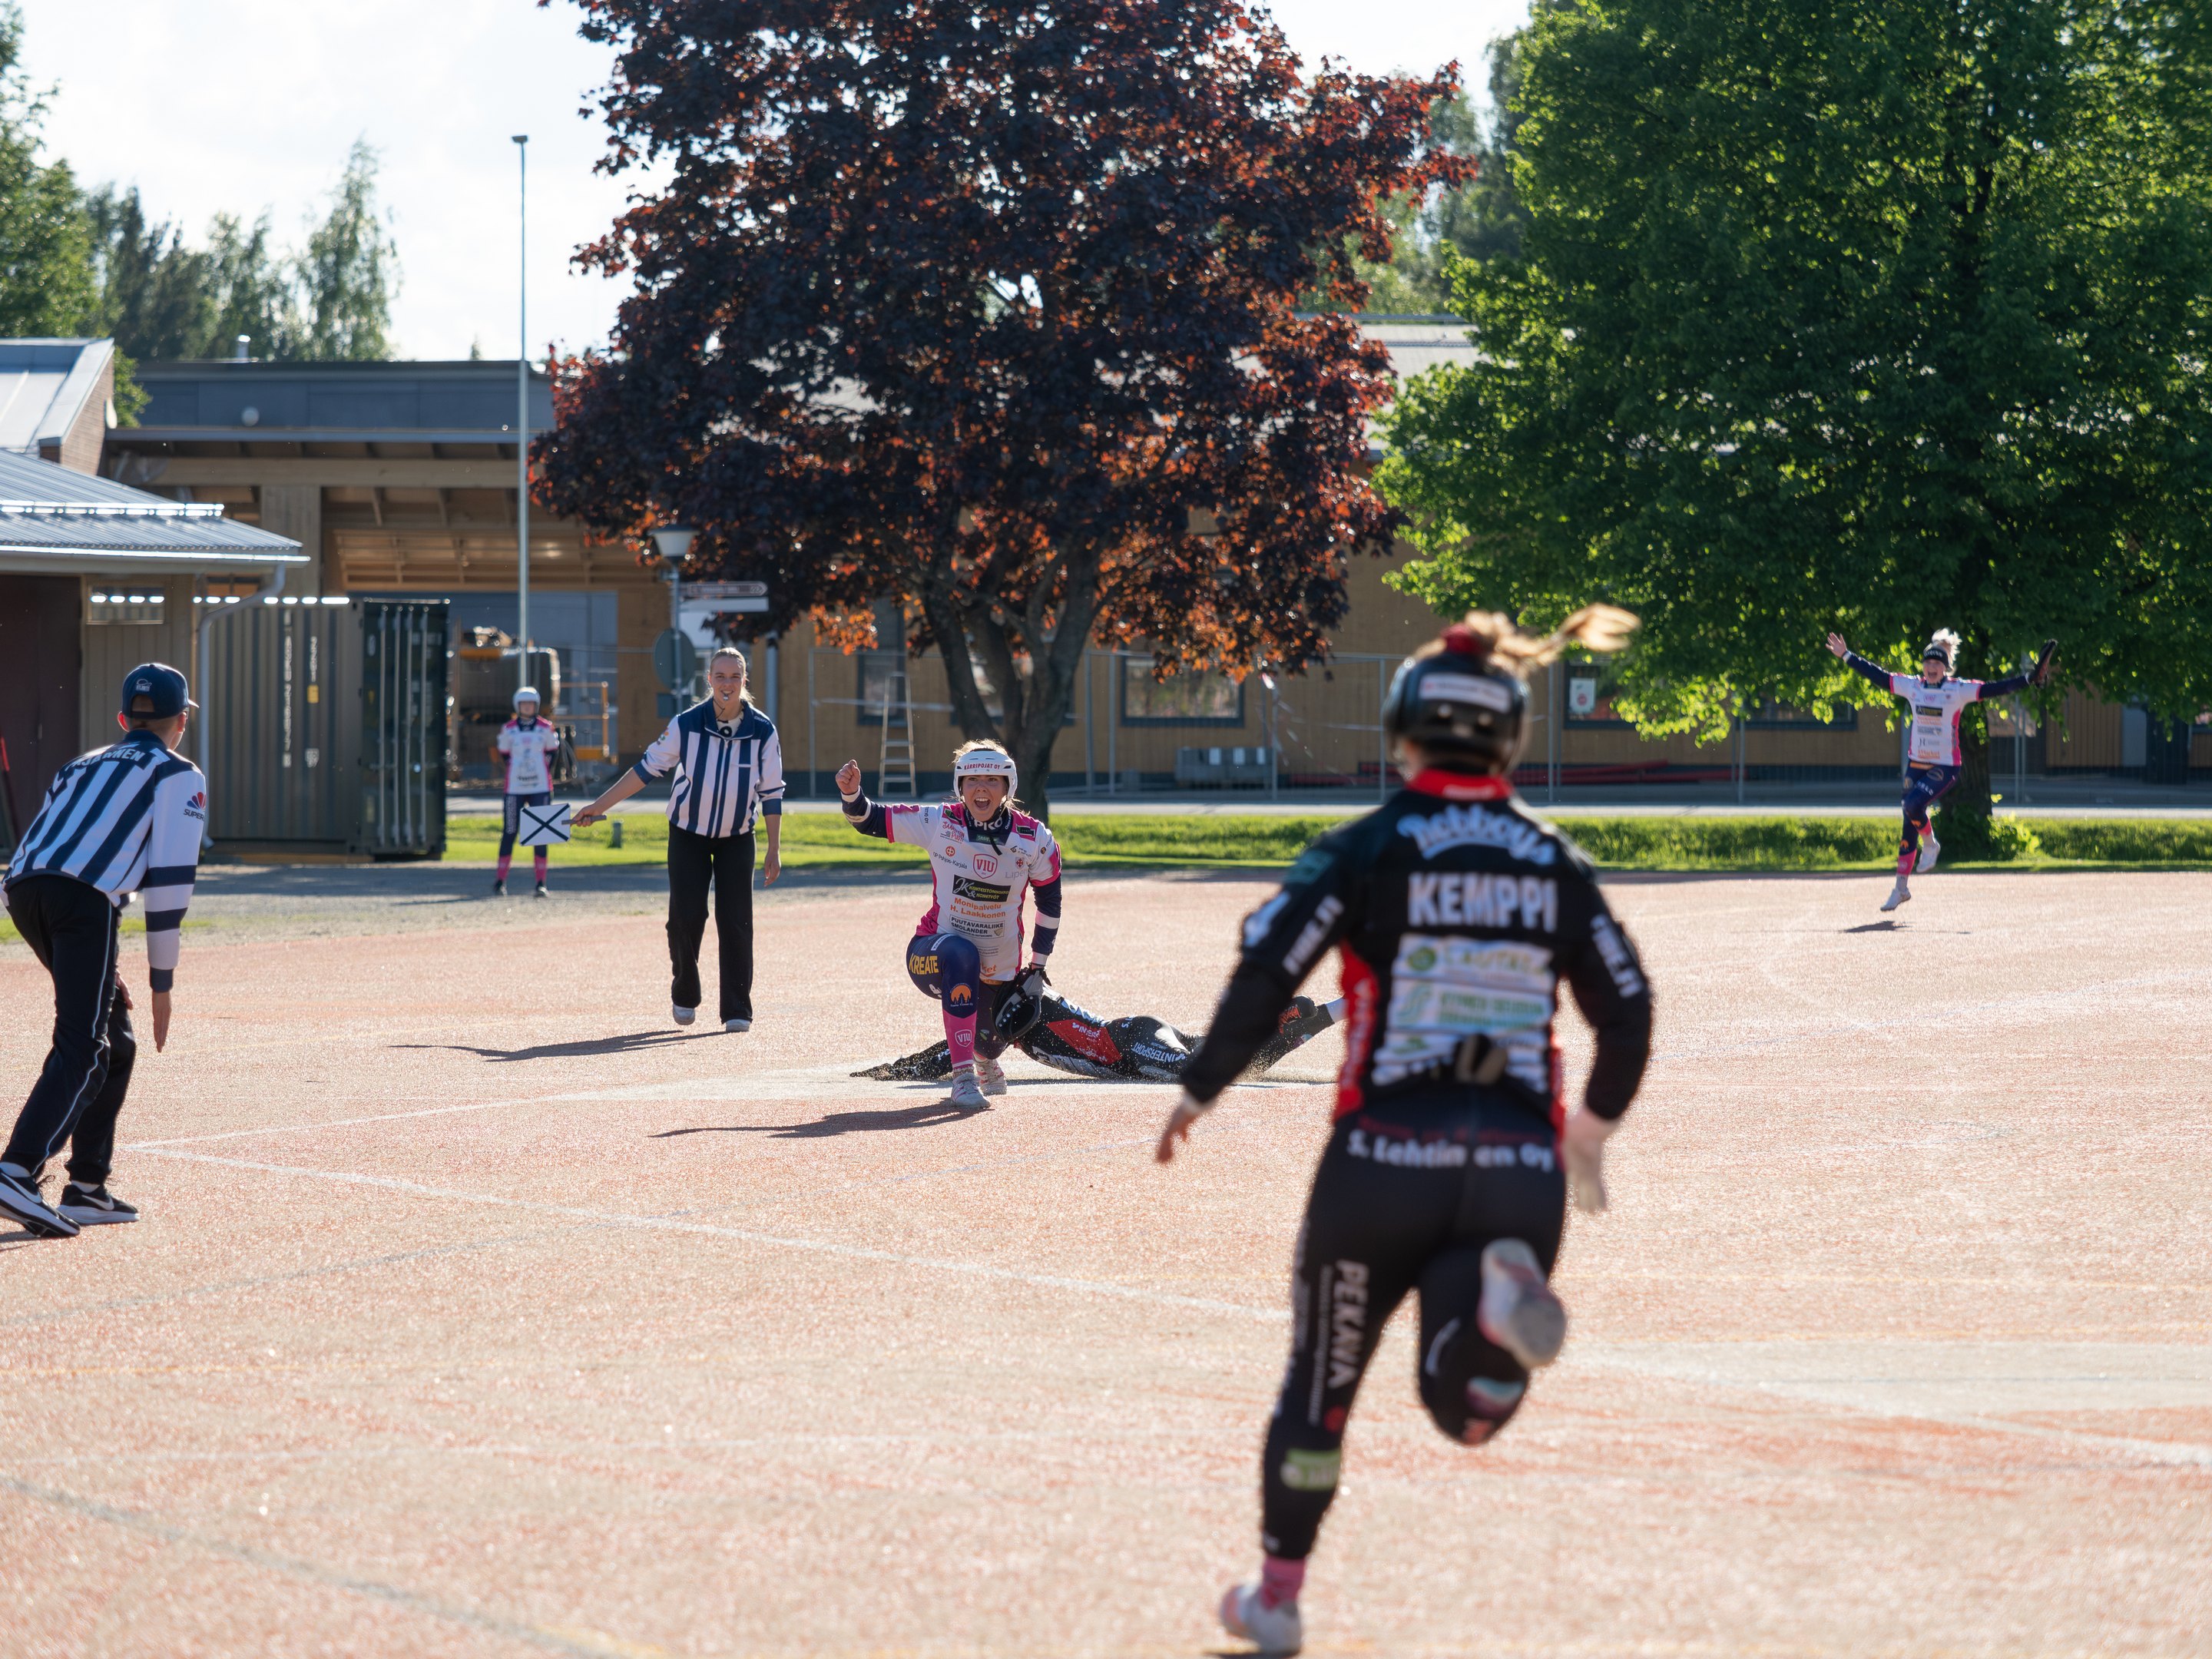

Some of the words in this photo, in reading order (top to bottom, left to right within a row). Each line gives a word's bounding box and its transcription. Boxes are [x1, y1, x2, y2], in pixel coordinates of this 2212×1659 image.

[976, 859, 995, 873] VIU
[954, 897, 1002, 911] Monipalvelu
[1408, 872, 1558, 933] KEMPPI
[961, 908, 1006, 919] Laakkonen
[951, 916, 1004, 929] PUUTAVARALIIKE
[951, 922, 988, 934] SMOLANDER
[909, 953, 939, 975] KREATE
[958, 1033, 971, 1043] VIU
[1131, 1041, 1176, 1063] INTERSPORT
[1327, 1258, 1369, 1389] PEKAVA
